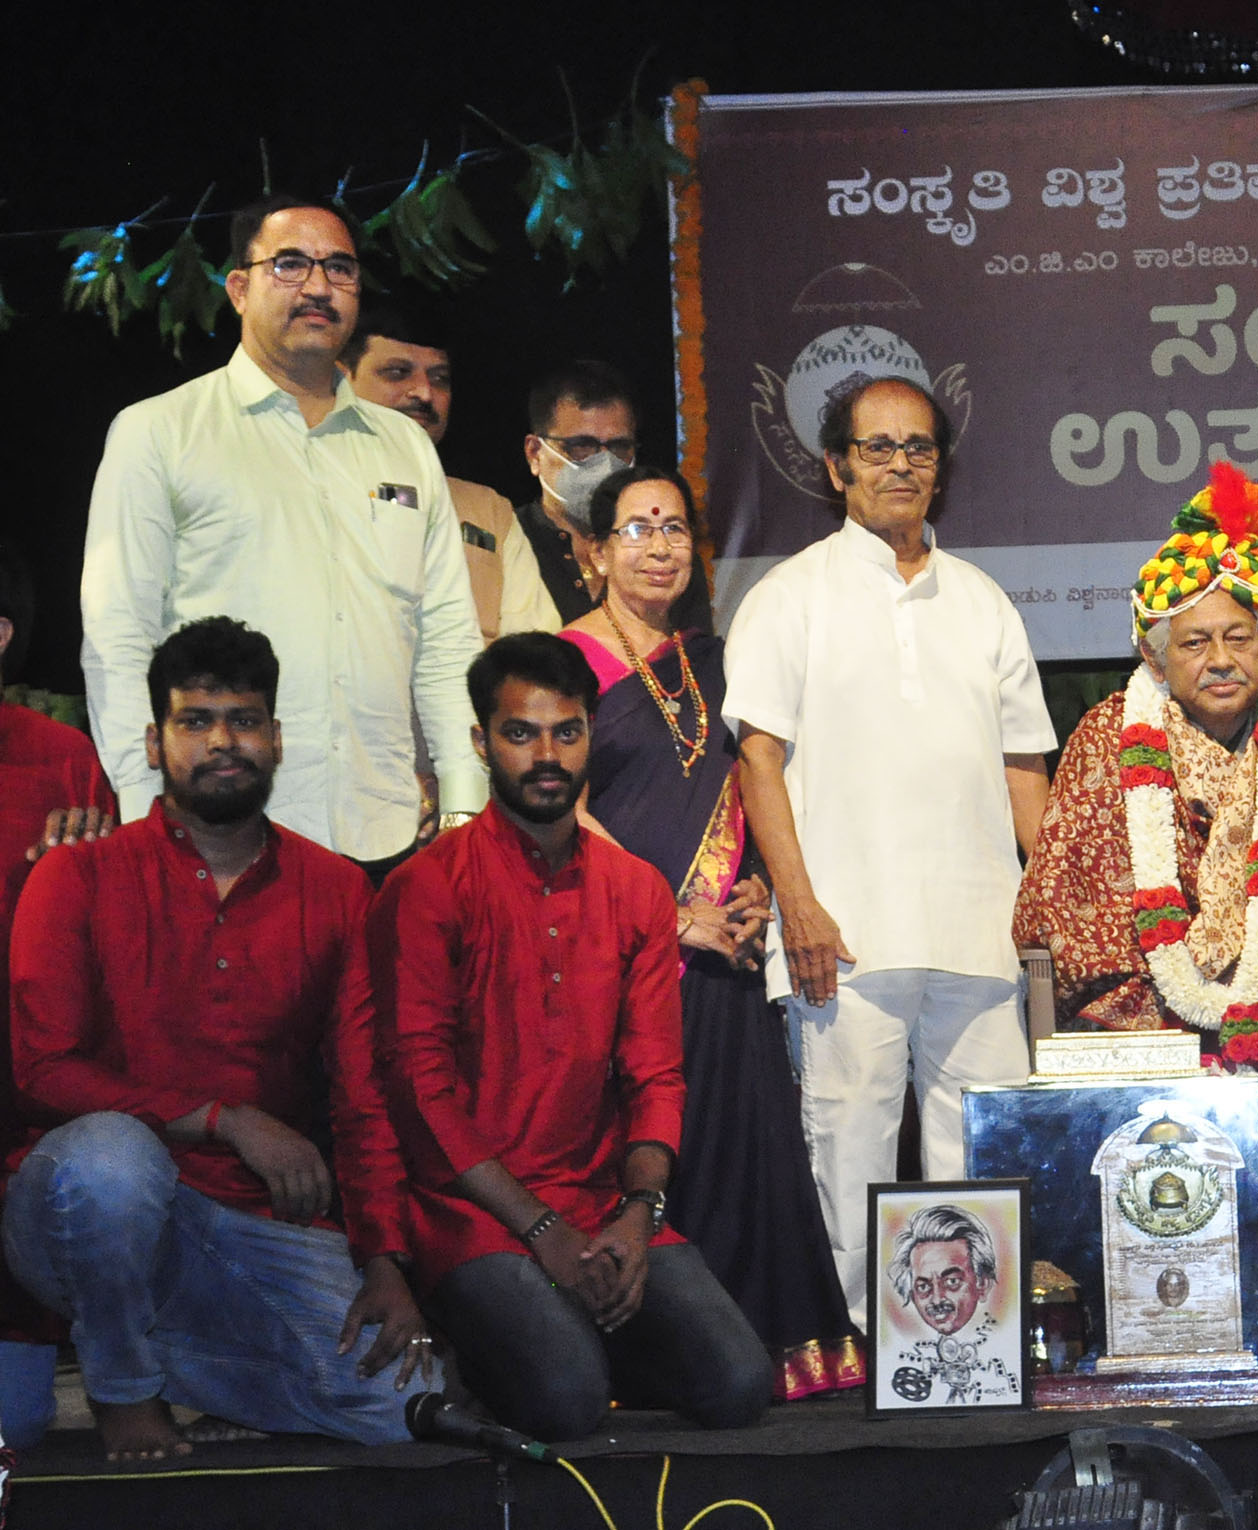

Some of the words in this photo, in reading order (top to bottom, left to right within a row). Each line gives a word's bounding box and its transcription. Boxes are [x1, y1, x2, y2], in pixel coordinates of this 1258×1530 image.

[827, 164, 1011, 246] ಸಂಸ್ಕೃತಿ
[1041, 157, 1127, 229] ವಿಶ್ವ
[984, 249, 1119, 275] ಎಂ.ಜಿ.ಎಂ
[1133, 241, 1258, 270] ಕಾಲೇಜು,
